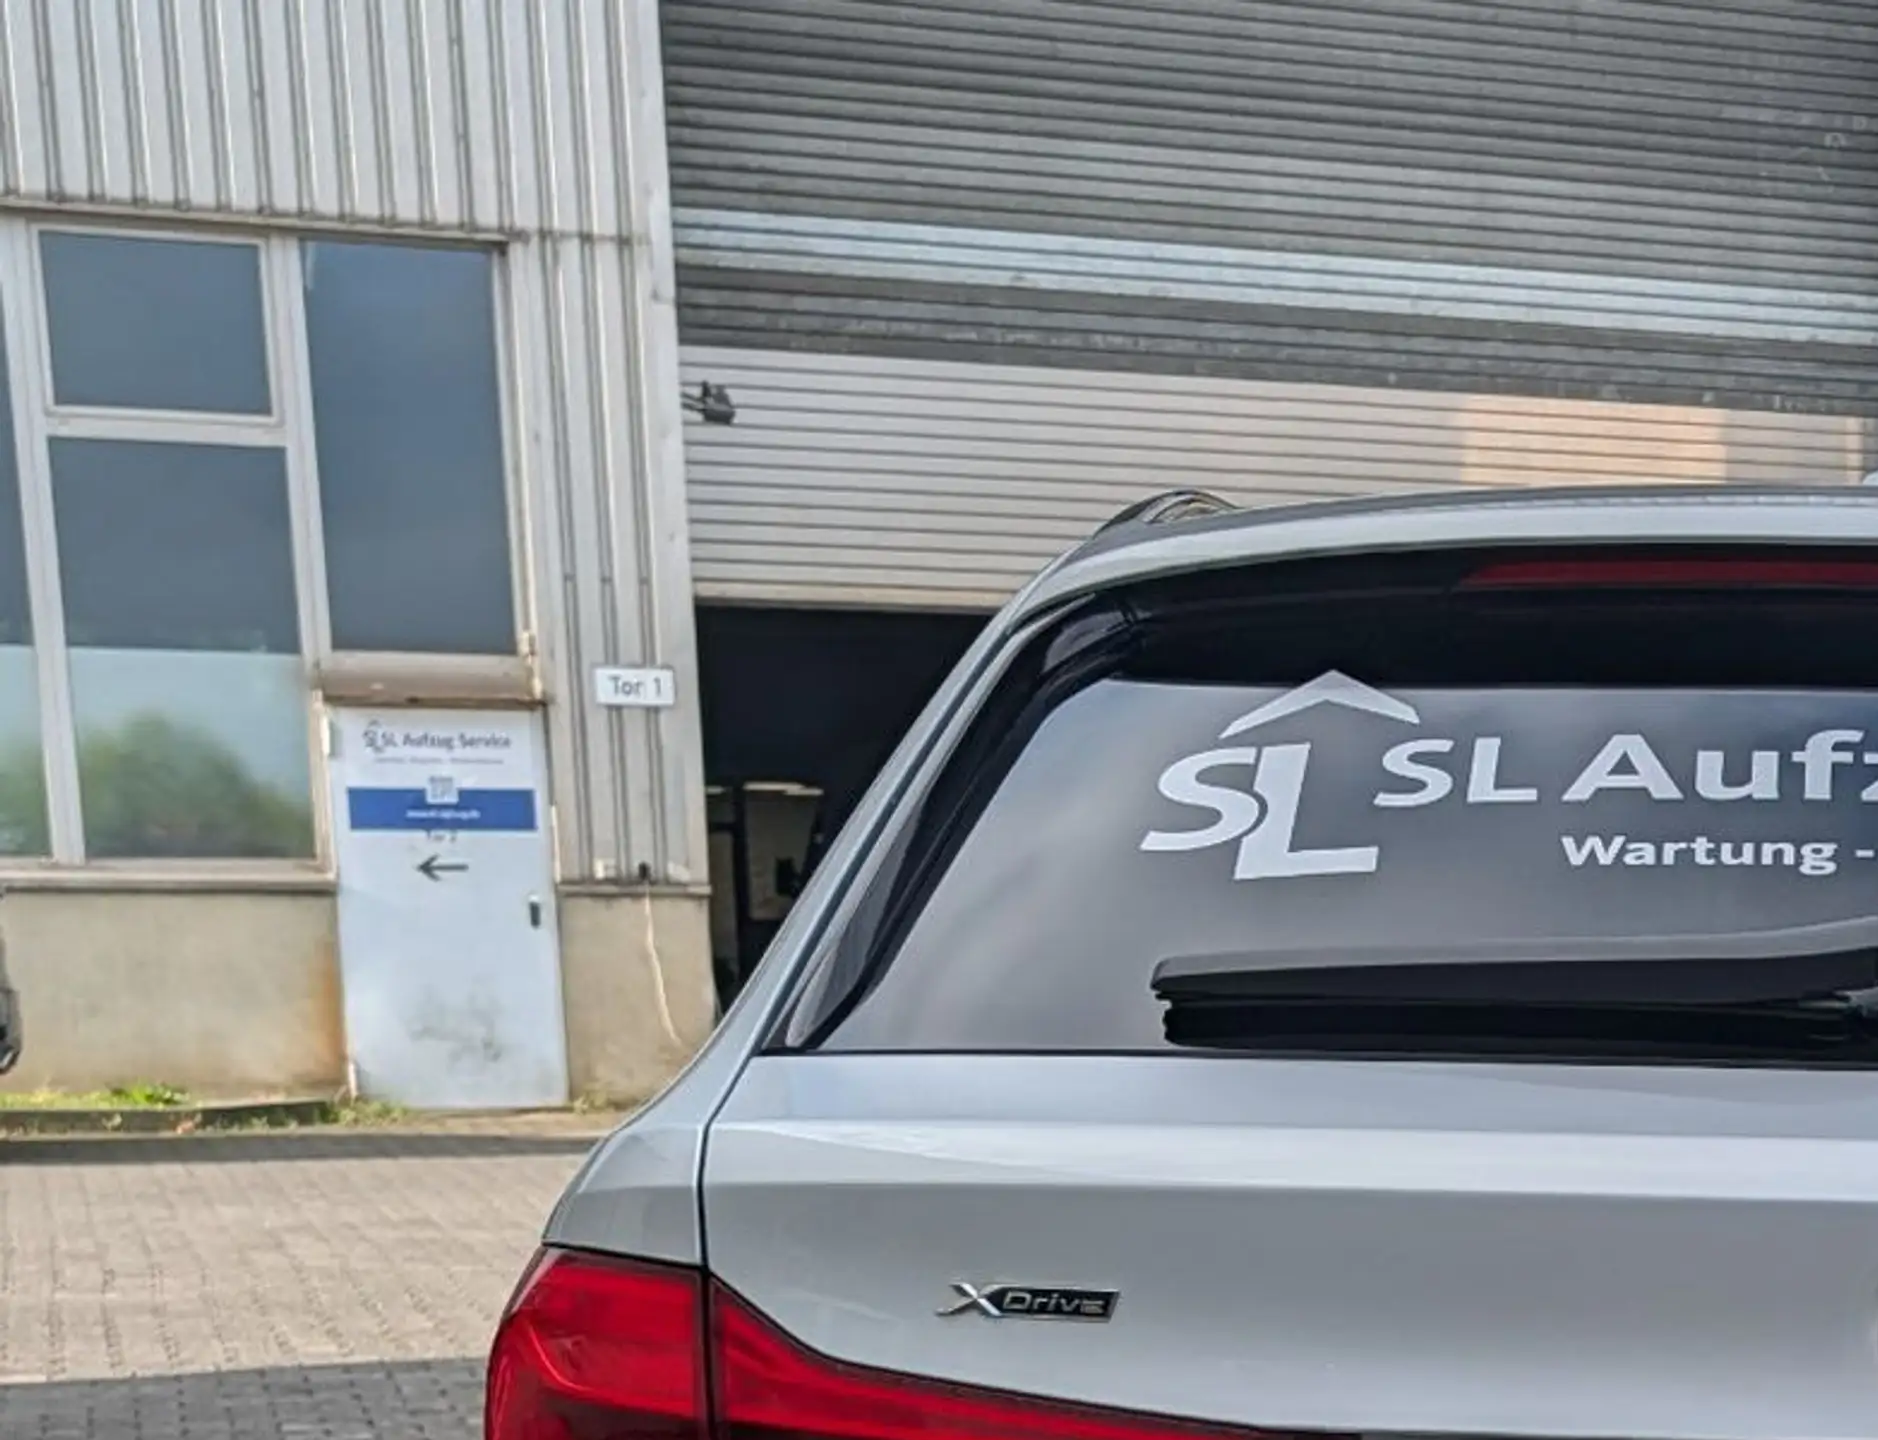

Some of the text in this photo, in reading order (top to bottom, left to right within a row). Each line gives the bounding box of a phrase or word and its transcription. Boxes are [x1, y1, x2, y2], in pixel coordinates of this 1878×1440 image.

[607, 676, 662, 696] Tor 1
[402, 732, 455, 751] Aufzug
[458, 732, 512, 749] Service
[1375, 736, 1538, 807] SL
[1561, 835, 1837, 876] Wartung
